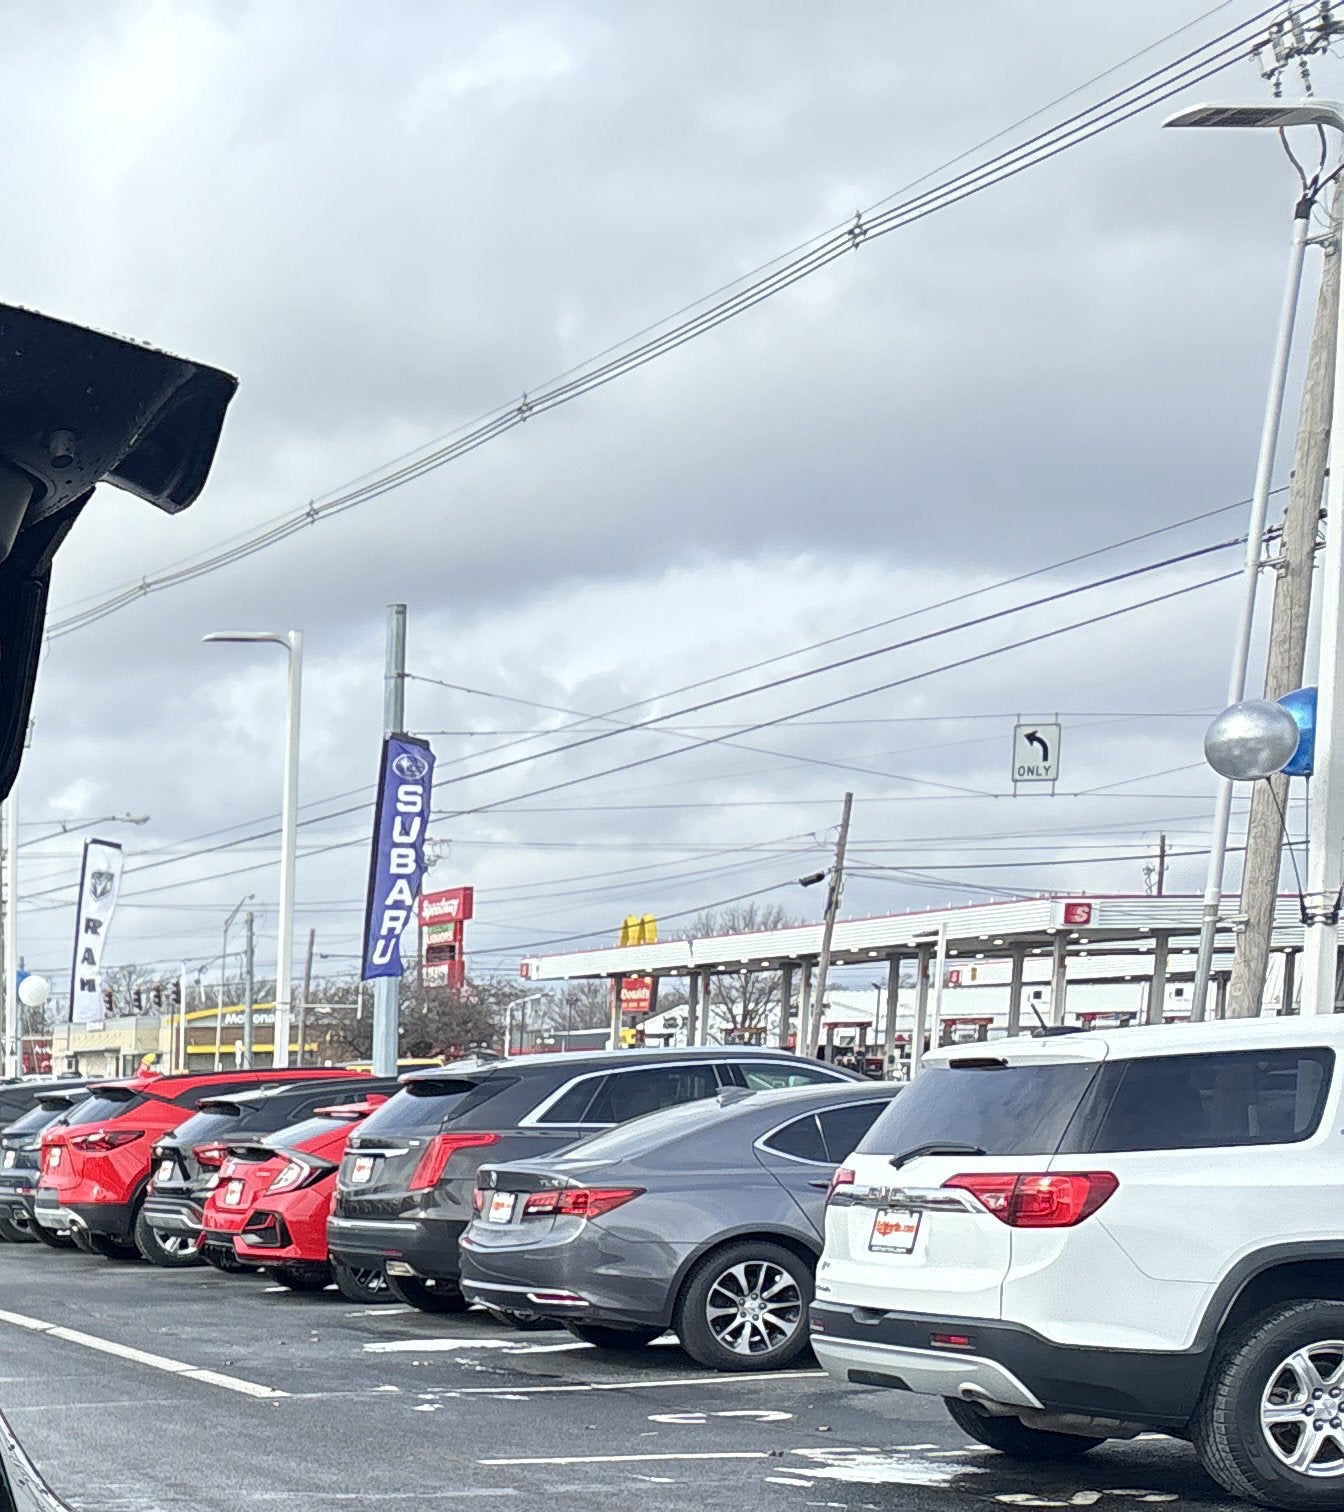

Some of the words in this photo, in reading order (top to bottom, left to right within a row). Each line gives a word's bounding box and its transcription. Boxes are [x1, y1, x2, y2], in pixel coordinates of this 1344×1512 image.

[1017, 765, 1051, 777] ONLY
[372, 783, 424, 966] SUBARU
[80, 916, 104, 993] RAM
